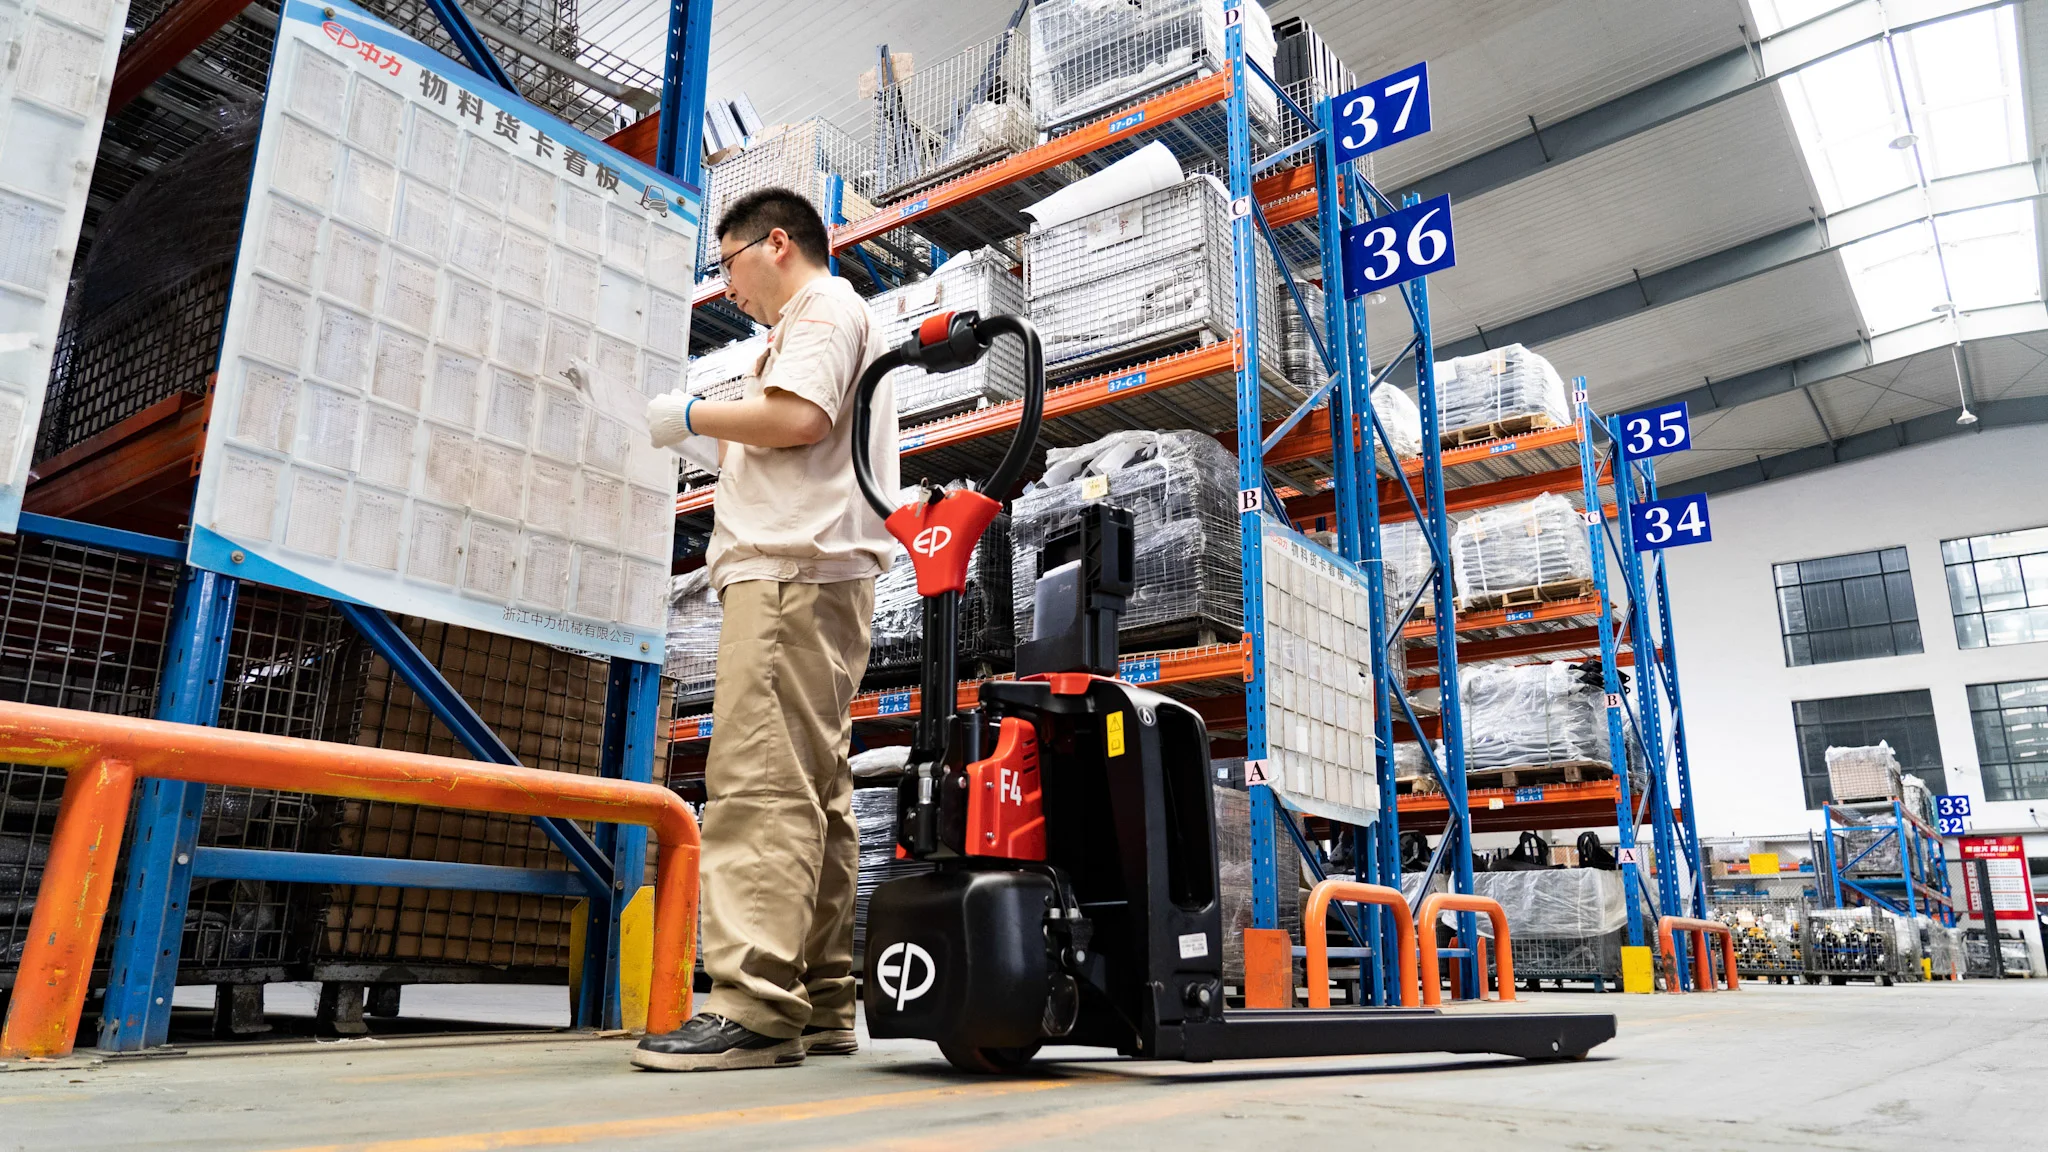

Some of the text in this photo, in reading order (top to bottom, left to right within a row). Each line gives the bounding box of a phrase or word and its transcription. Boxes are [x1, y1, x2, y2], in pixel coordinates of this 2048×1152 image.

[1224, 9, 1239, 27] D
[1342, 75, 1420, 150] 37
[419, 68, 620, 195] 物料货卡看板
[1109, 112, 1143, 133] 37-D-1
[1231, 198, 1246, 216] C
[1363, 207, 1447, 281] 36
[1109, 374, 1143, 391] 37-C-1
[1575, 391, 1585, 402] D
[1626, 410, 1686, 454] 35
[1490, 442, 1515, 454] 35-D-1
[1242, 490, 1257, 510] B
[1588, 513, 1598, 523] C
[1644, 501, 1706, 543] 34
[913, 525, 952, 558] EP
[1291, 541, 1345, 582] 物料货卡看板
[1506, 611, 1531, 621] 35-C-1
[502, 606, 635, 646] 浙江中力机械有限公司
[1121, 661, 1157, 673] 37-B-1
[1121, 671, 1158, 684] 37-A-1
[879, 703, 909, 714] 37-A-2
[1607, 695, 1617, 706] B
[1248, 761, 1267, 782] A
[1000, 767, 1022, 806] F4
[1940, 798, 1969, 815] 33
[1938, 818, 1963, 834] 32
[1623, 849, 1634, 861] A
[877, 942, 936, 1011] EP
